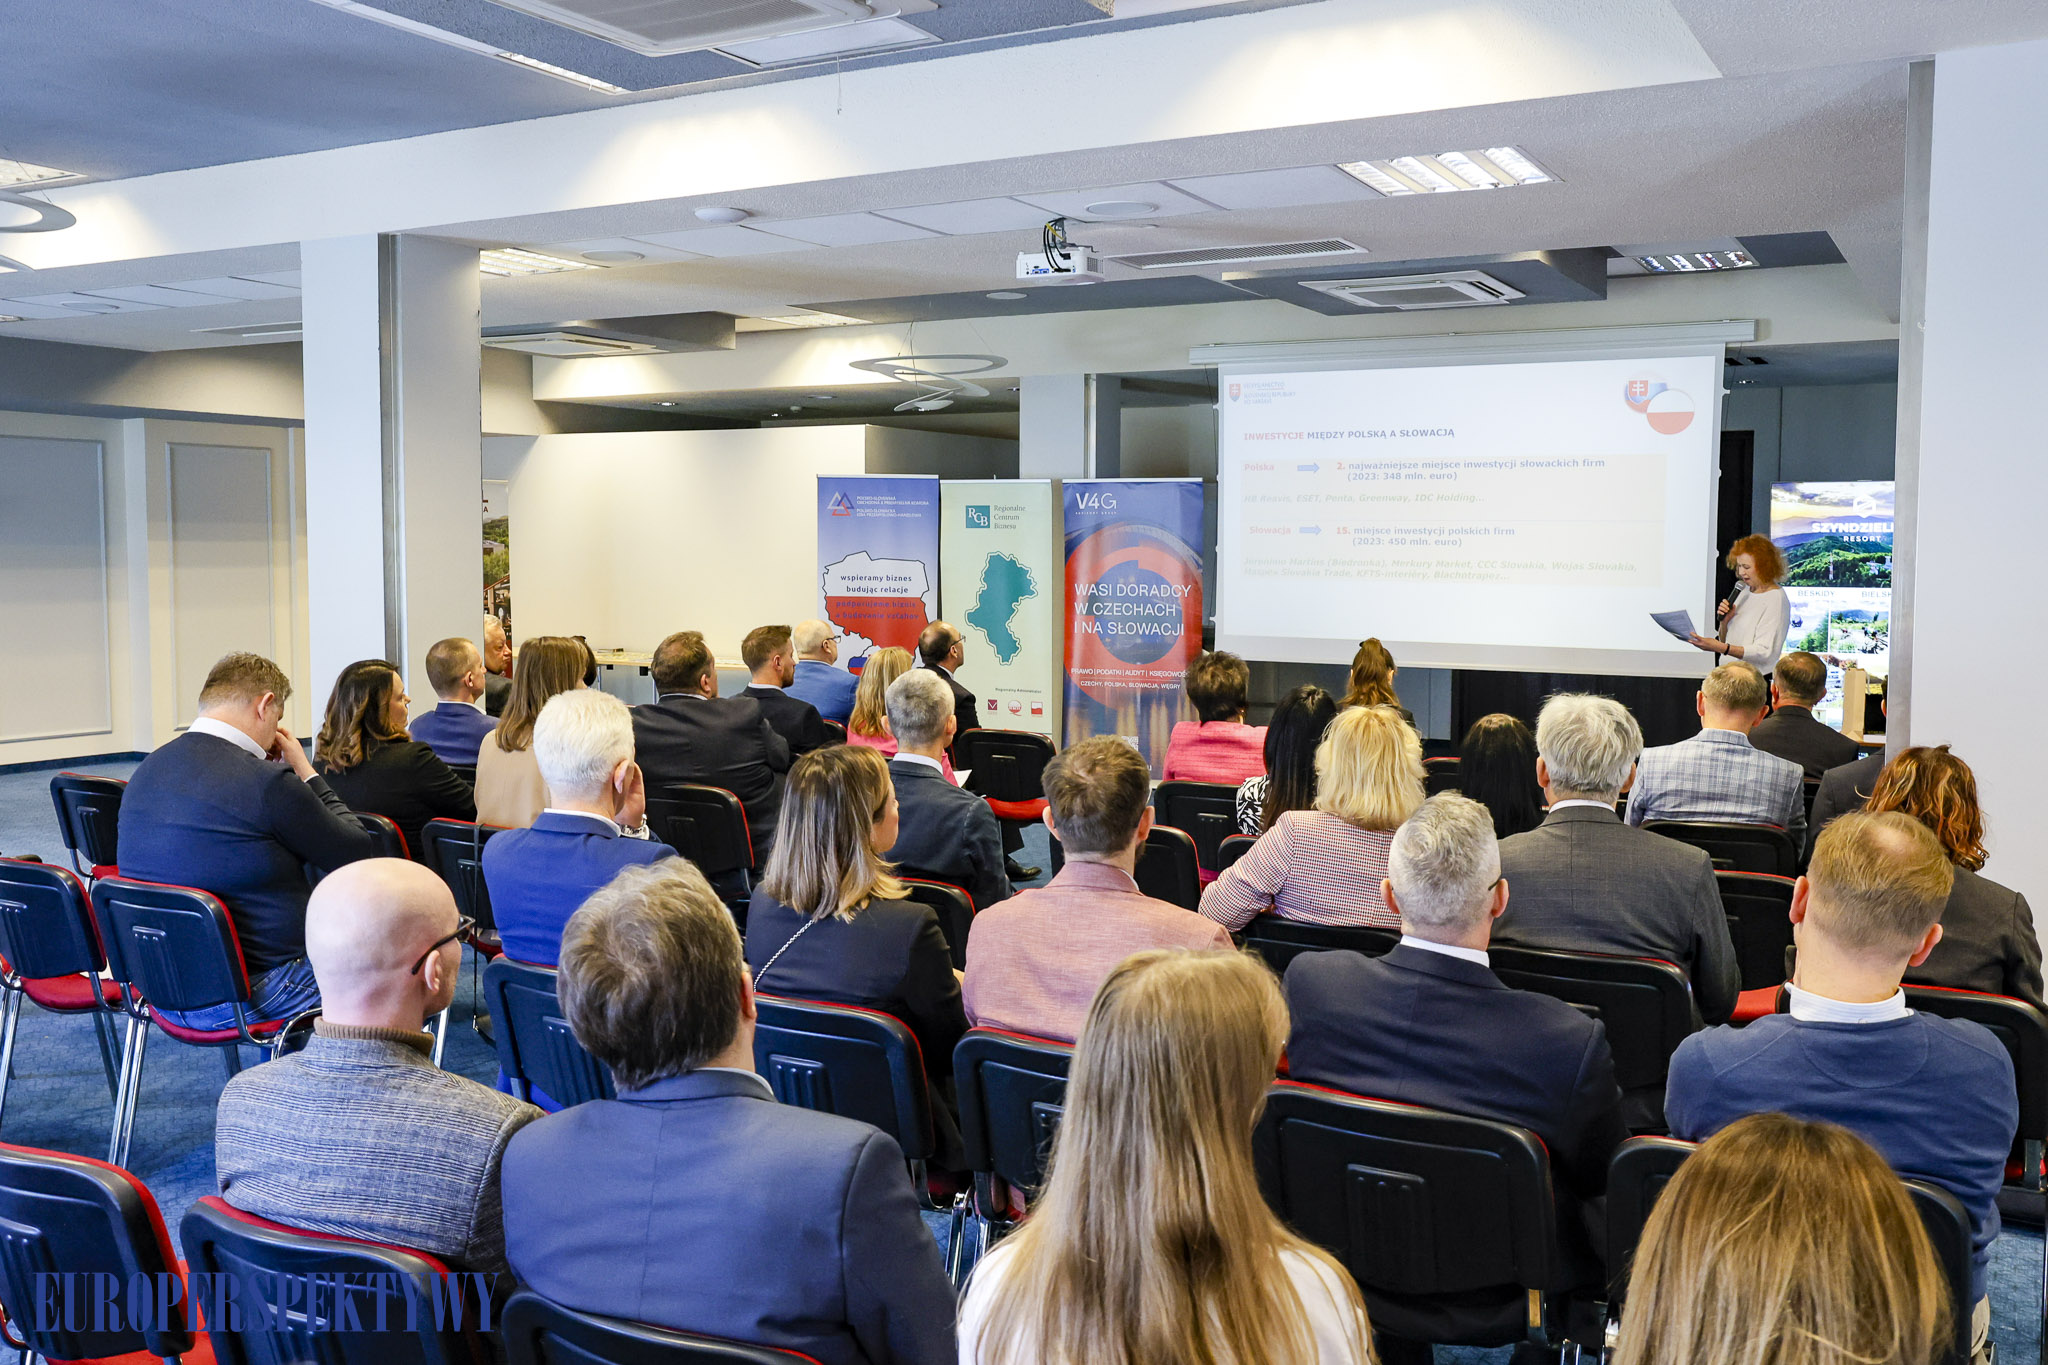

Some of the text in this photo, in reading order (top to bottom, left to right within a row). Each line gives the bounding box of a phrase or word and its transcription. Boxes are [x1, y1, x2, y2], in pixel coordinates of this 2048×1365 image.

[1244, 428, 1455, 441] INWESTYCJE MIĘDZY POLSKĄ A SŁOWACJĄ
[1244, 462, 1275, 472] Polska
[1336, 458, 1606, 472] 2. najważniejsze miejsce inwestycji słowackich firm
[1347, 471, 1458, 482] (2023: 348 mln. euro)
[1075, 492, 1117, 510] V4G
[1296, 494, 1322, 503] ESET,
[1325, 494, 1355, 503] Penta,
[1359, 493, 1411, 504] Greenway,
[1414, 494, 1434, 502] IDC
[993, 504, 1026, 513] Regionalne
[993, 513, 1020, 521] Centrum
[1336, 526, 1515, 537] 15. miejsce inwestycji polskich firm
[1352, 537, 1463, 548] (2023: 450 mln. euro)
[1843, 535, 1881, 543] RESORT
[1390, 559, 1432, 570] Merkury
[1477, 560, 1498, 569] CCC
[1551, 560, 1585, 571] Wojas
[840, 574, 912, 582] wspieramy biznes
[846, 585, 909, 594] budując relacje
[1074, 583, 1192, 598] WASI DORADCY
[1797, 589, 1835, 598] BESKIDY
[1074, 602, 1176, 617] W CZECHACH
[1074, 621, 1185, 636] I NA SŁOWACJI
